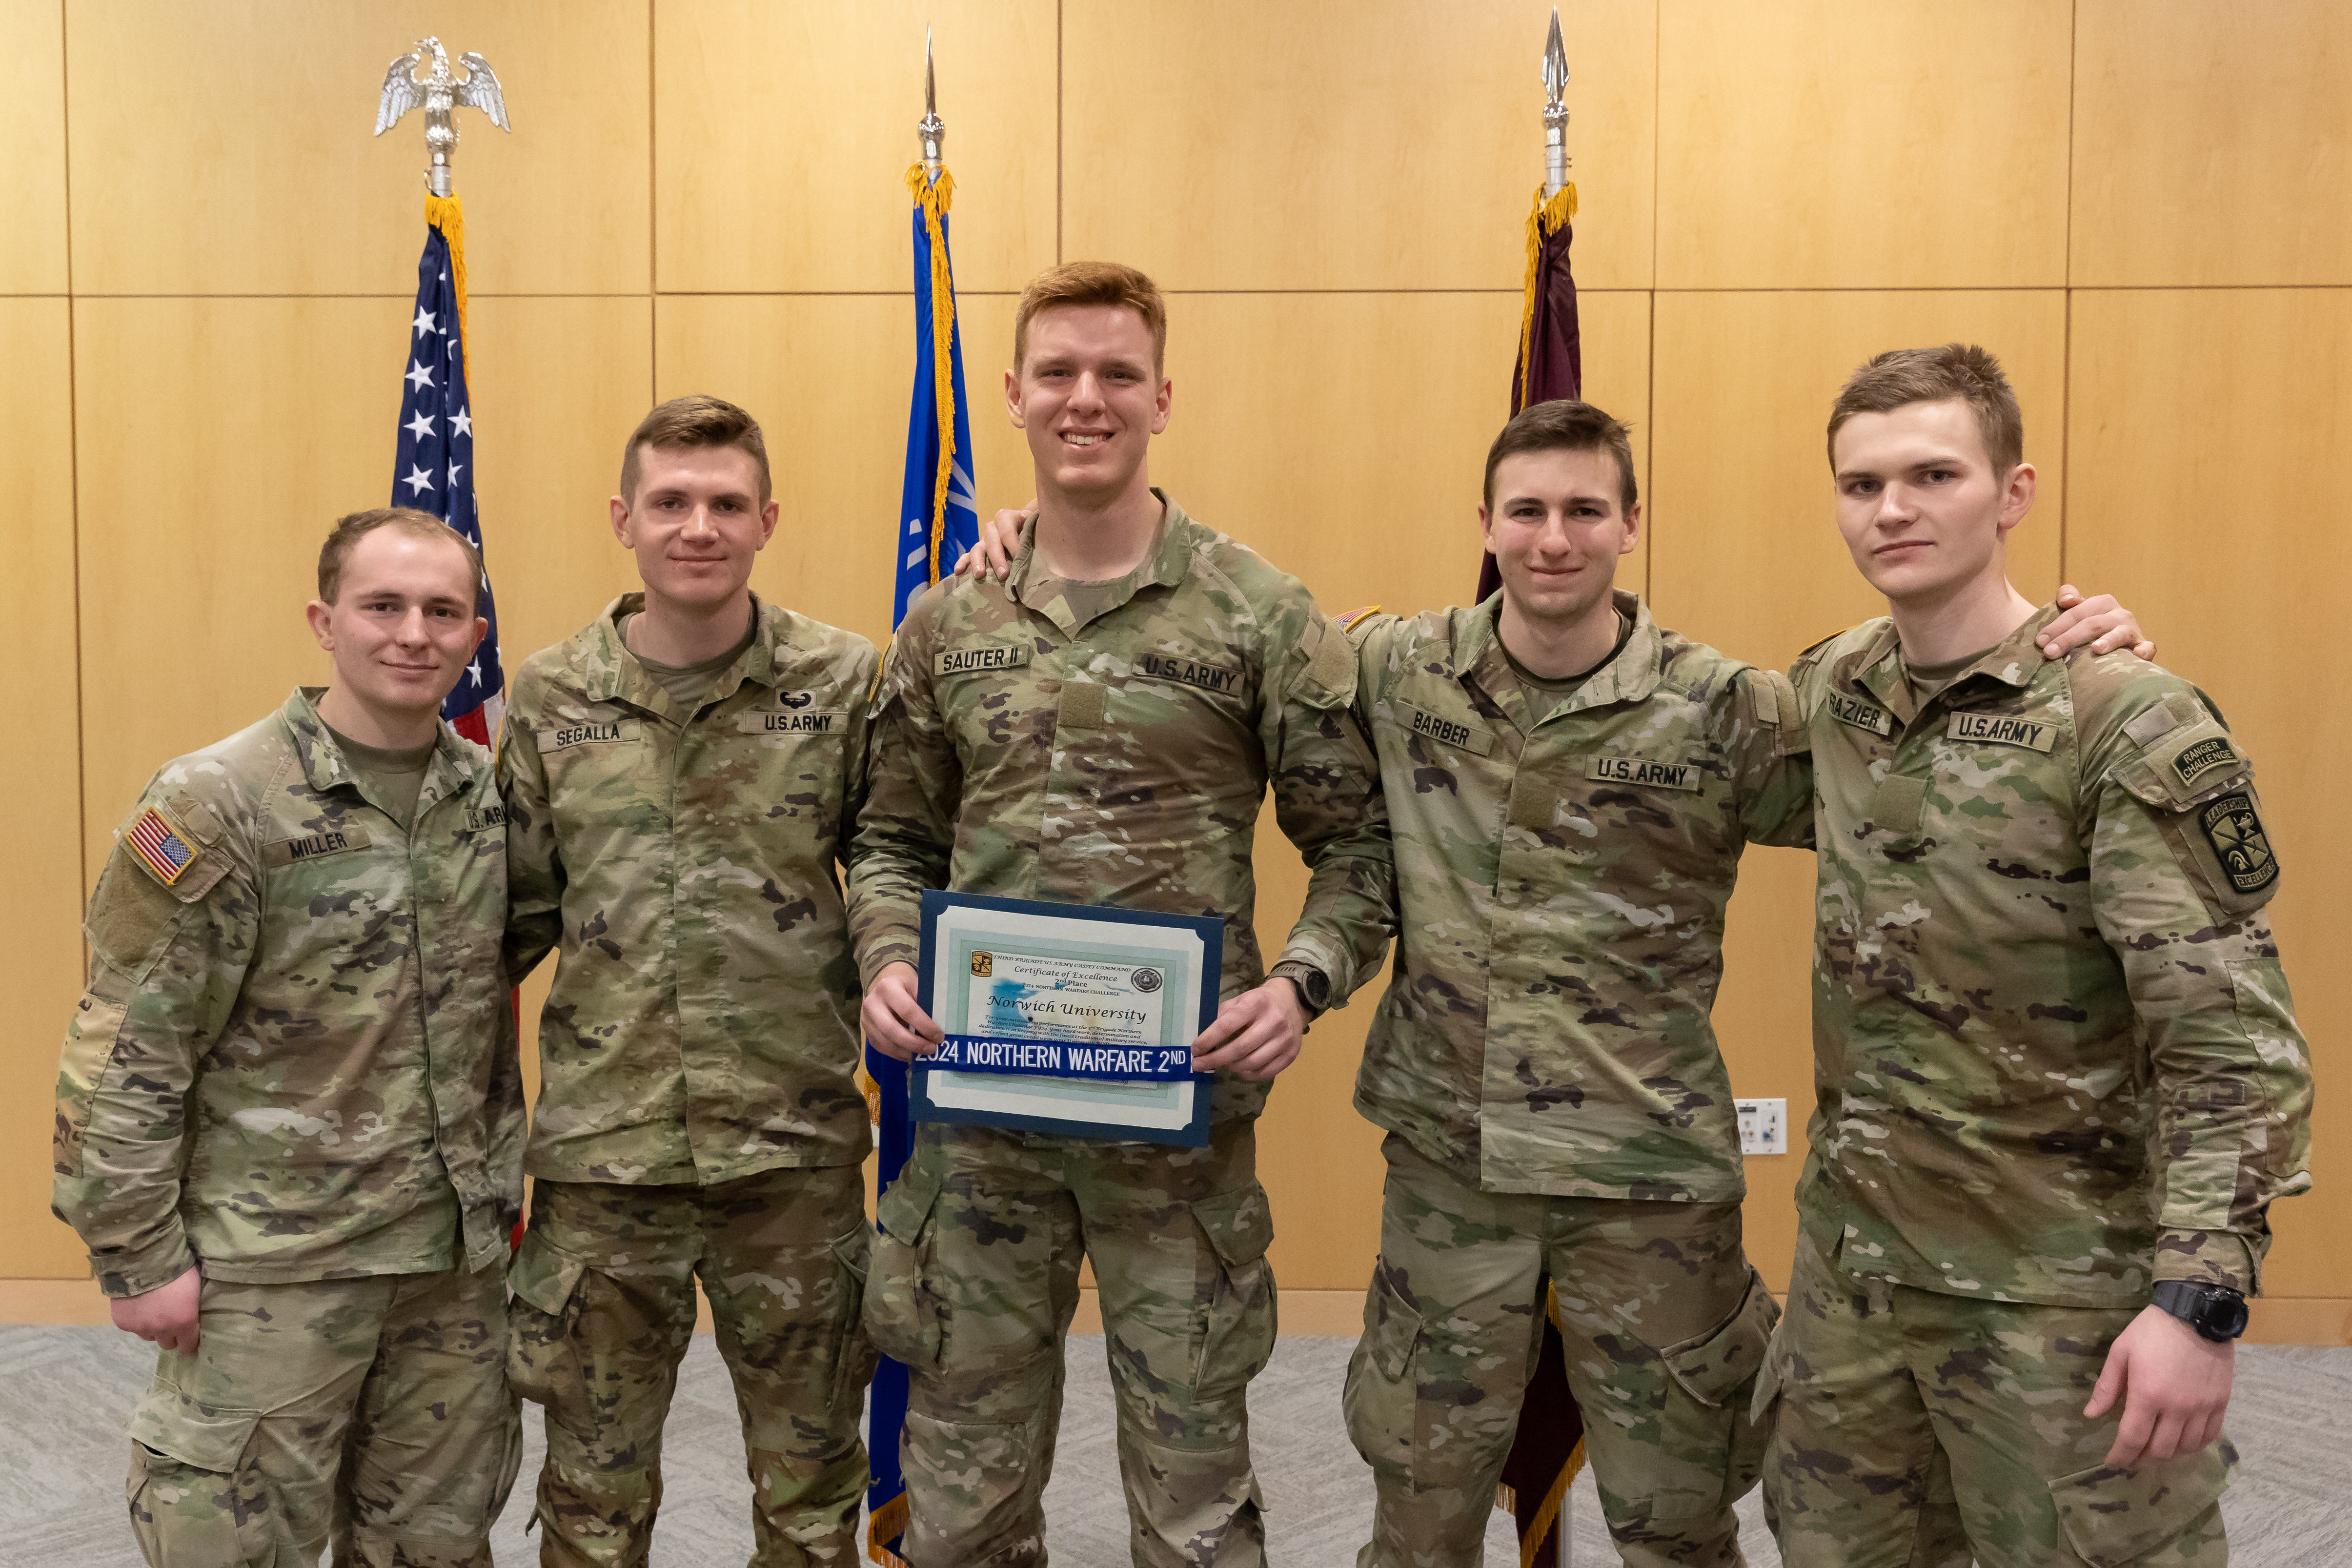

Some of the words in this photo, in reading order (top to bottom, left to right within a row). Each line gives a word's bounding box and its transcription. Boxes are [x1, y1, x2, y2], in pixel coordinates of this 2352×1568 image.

[943, 649, 1004, 672] SAUTER
[1009, 647, 1018, 664] II
[1829, 692, 1881, 728] FRAZIER
[557, 723, 620, 746] SEGALLA
[1413, 711, 1470, 746] BARBER
[2183, 741, 2221, 764] RANGER
[2183, 750, 2233, 778] CHALLENGE
[2206, 798, 2249, 824] LEADERSHIP
[289, 832, 348, 859] MILLER
[1014, 966, 1059, 977] Certificate
[1061, 971, 1072, 979] of
[1073, 972, 1117, 982] Excellence
[986, 995, 1056, 1013] Norwich
[1060, 1003, 1146, 1024] University
[967, 1041, 1061, 1069] NORTHERN
[1068, 1048, 1154, 1073] WARFARE
[1157, 1050, 1186, 1073] 2ND
